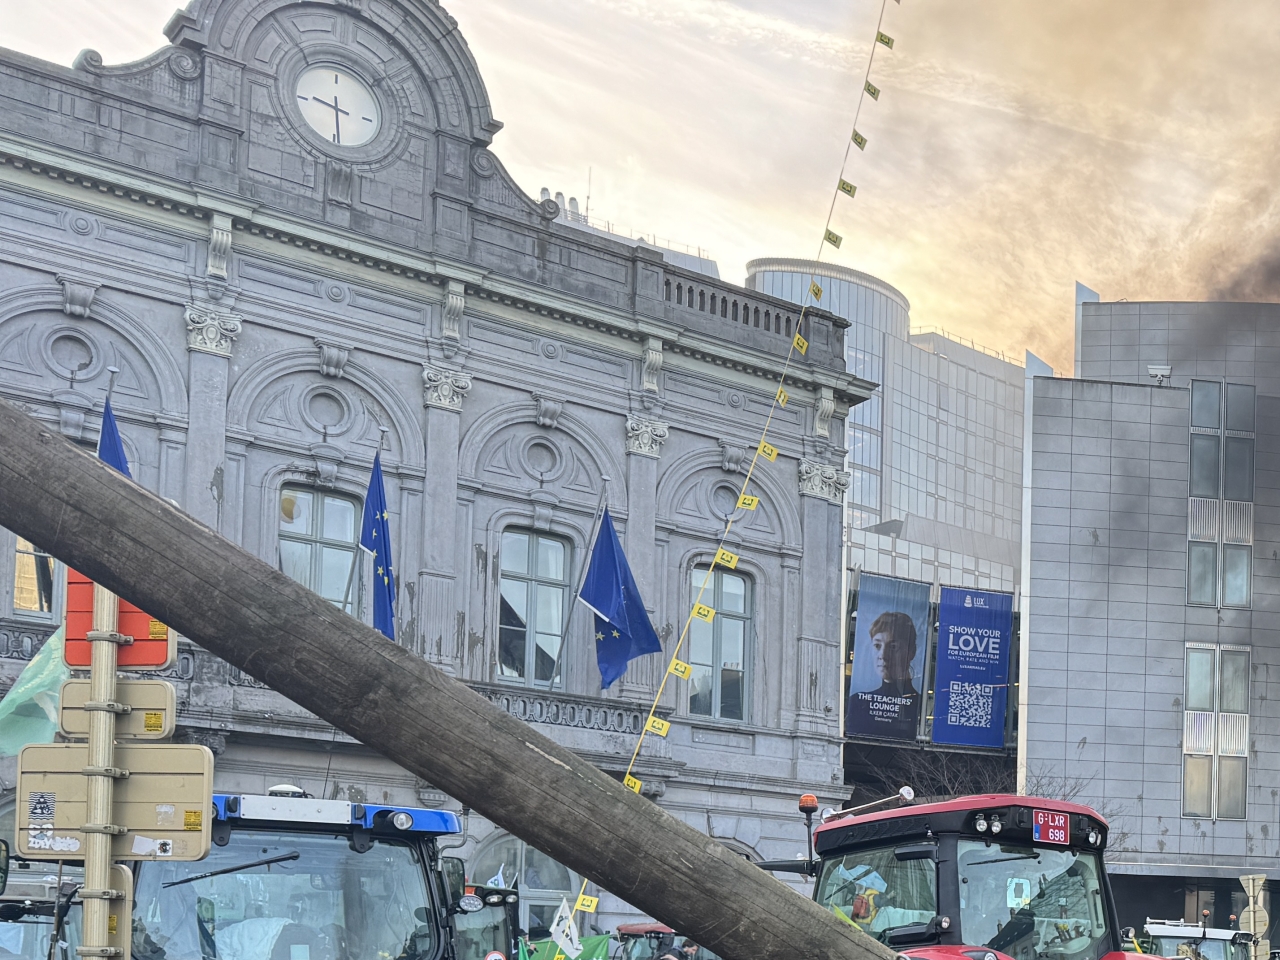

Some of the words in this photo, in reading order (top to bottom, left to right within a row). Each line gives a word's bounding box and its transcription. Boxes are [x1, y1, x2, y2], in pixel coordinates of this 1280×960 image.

[974, 598, 984, 606] LUX
[948, 626, 976, 635] SHOW
[978, 628, 1000, 638] YOUR
[948, 634, 1000, 654] LOVE
[959, 650, 987, 658] EUROPEAN
[858, 692, 872, 701] THE
[873, 694, 912, 706] TEACHERS'
[870, 702, 900, 712] LOUNGE
[1048, 828, 1065, 842] 698
